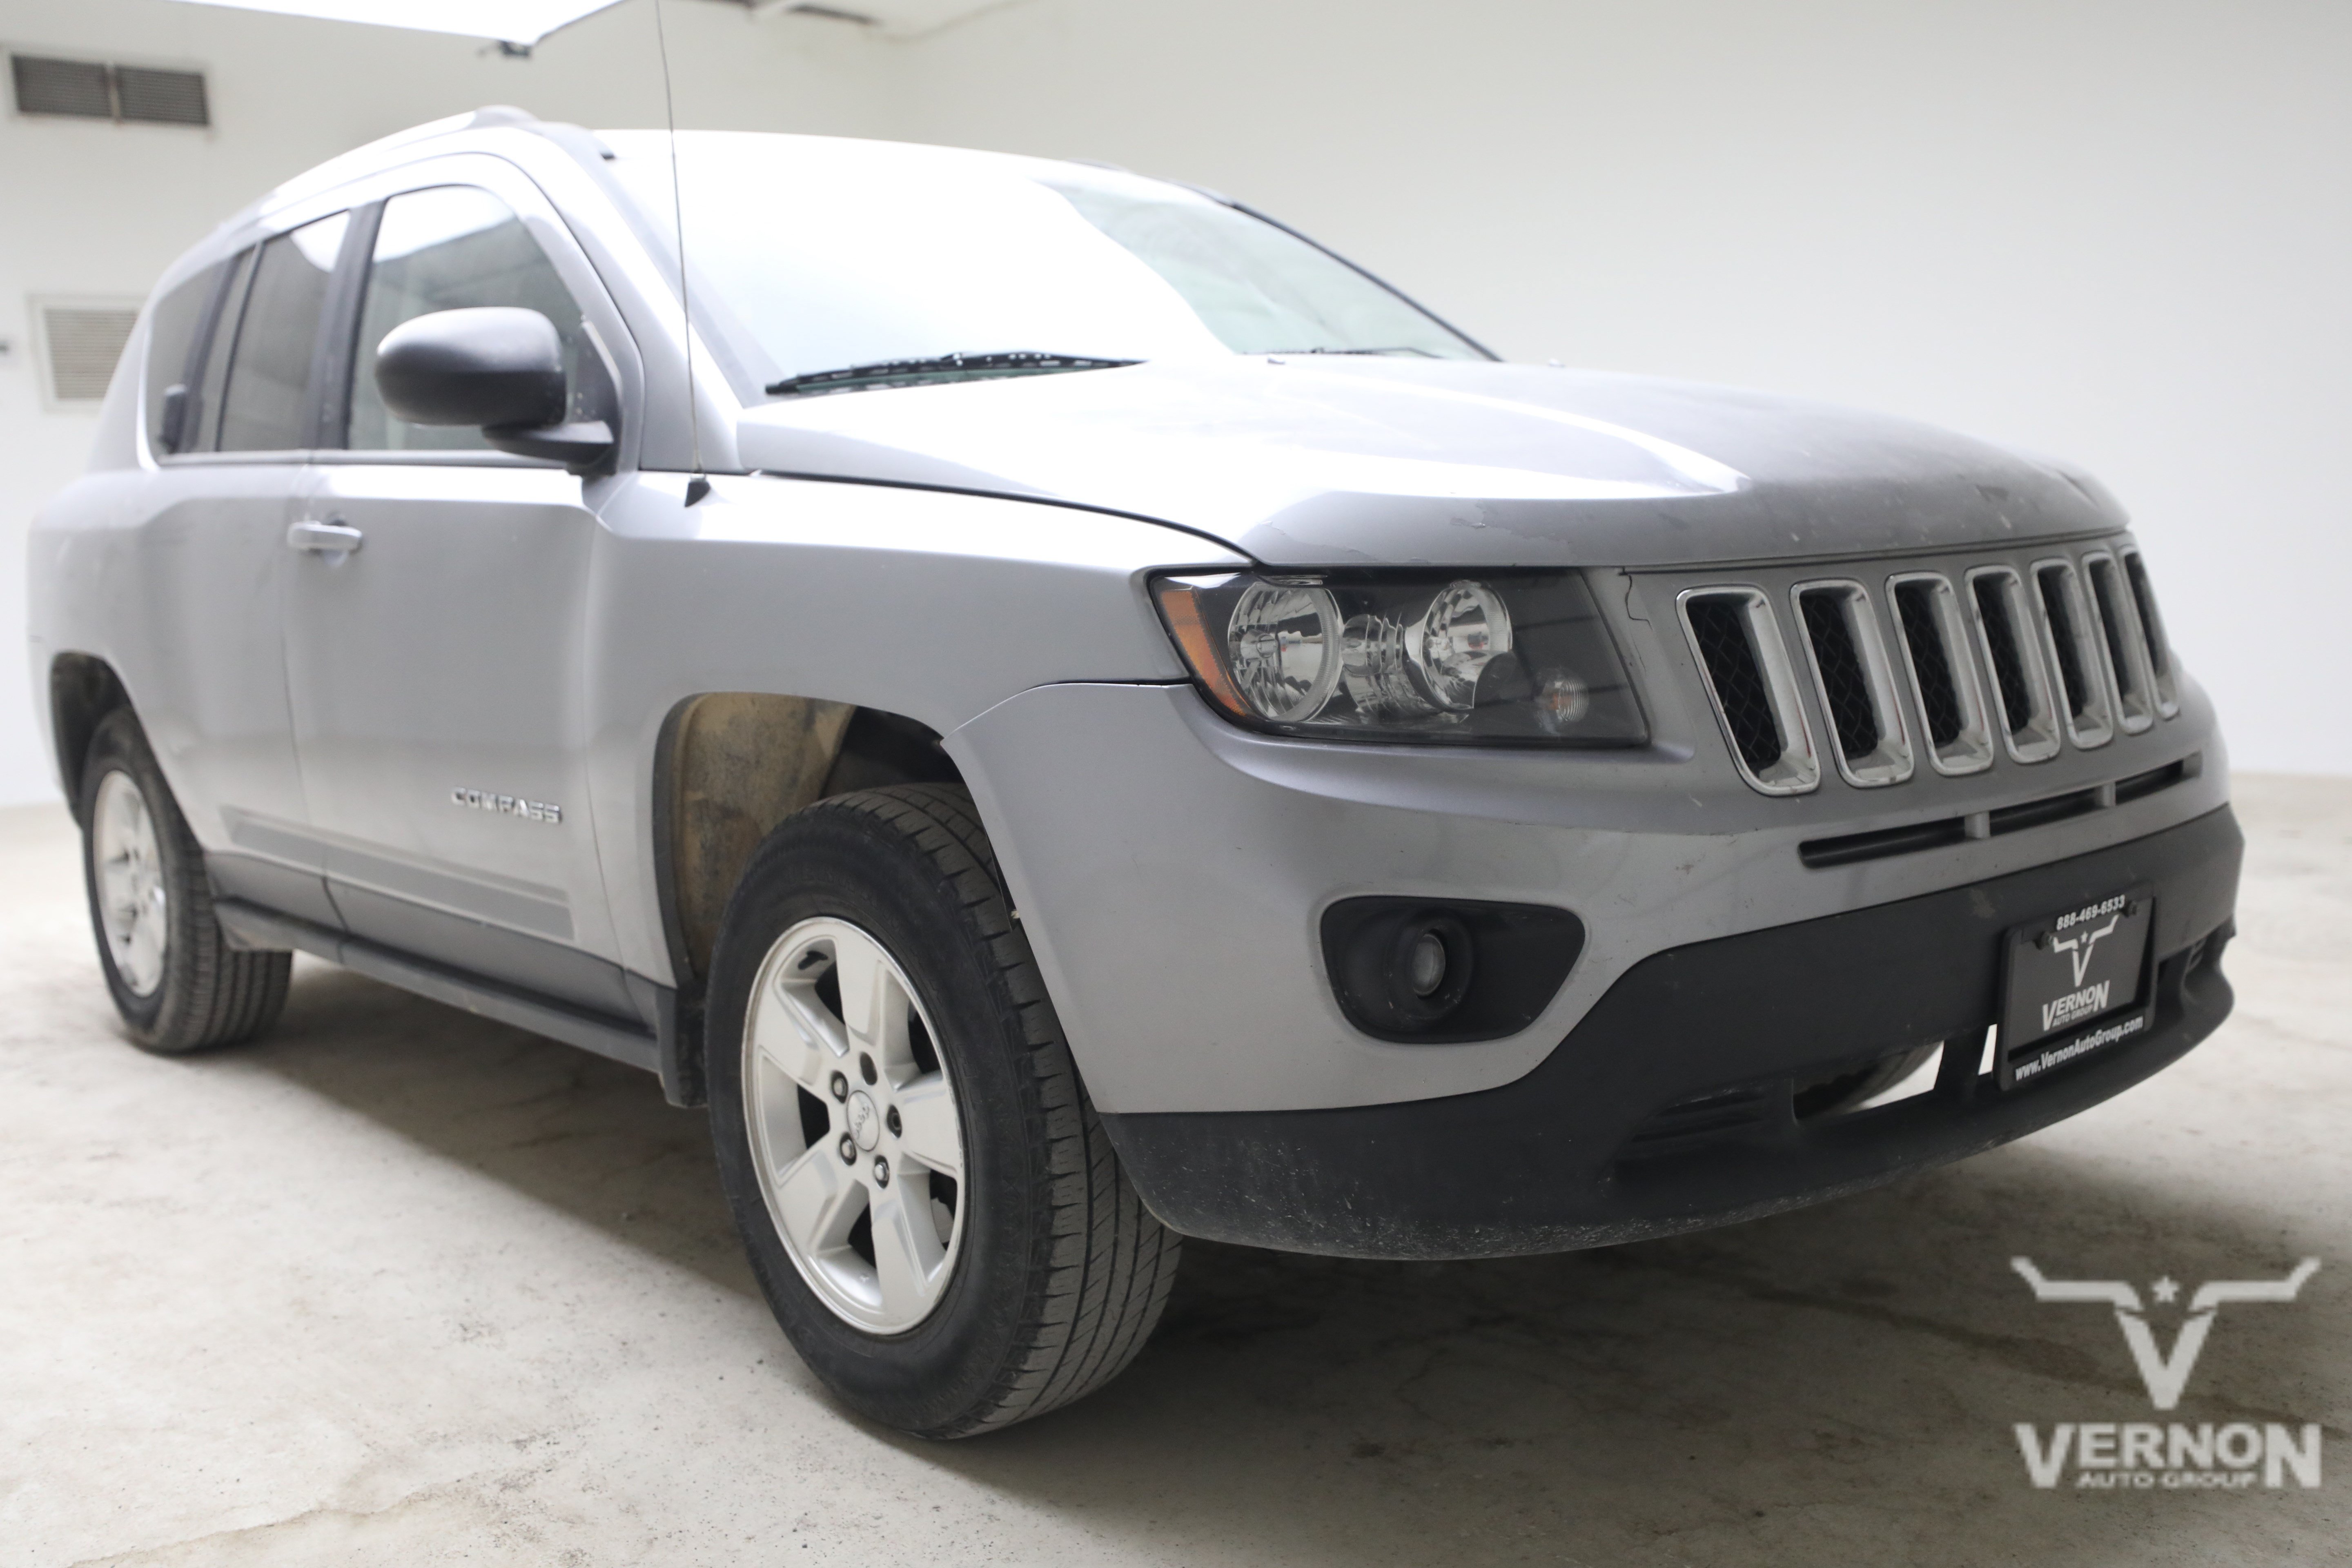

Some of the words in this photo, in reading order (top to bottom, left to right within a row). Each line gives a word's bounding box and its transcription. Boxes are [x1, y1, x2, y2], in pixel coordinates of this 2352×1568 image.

[451, 786, 562, 823] COMPASS
[2056, 894, 2125, 931] 888-469-6533
[2043, 980, 2110, 1031] VERNON
[2052, 1013, 2071, 1027] AUTO
[2071, 1004, 2094, 1020] GROUP
[2016, 1016, 2144, 1082] www.VernonAutoGroup.com
